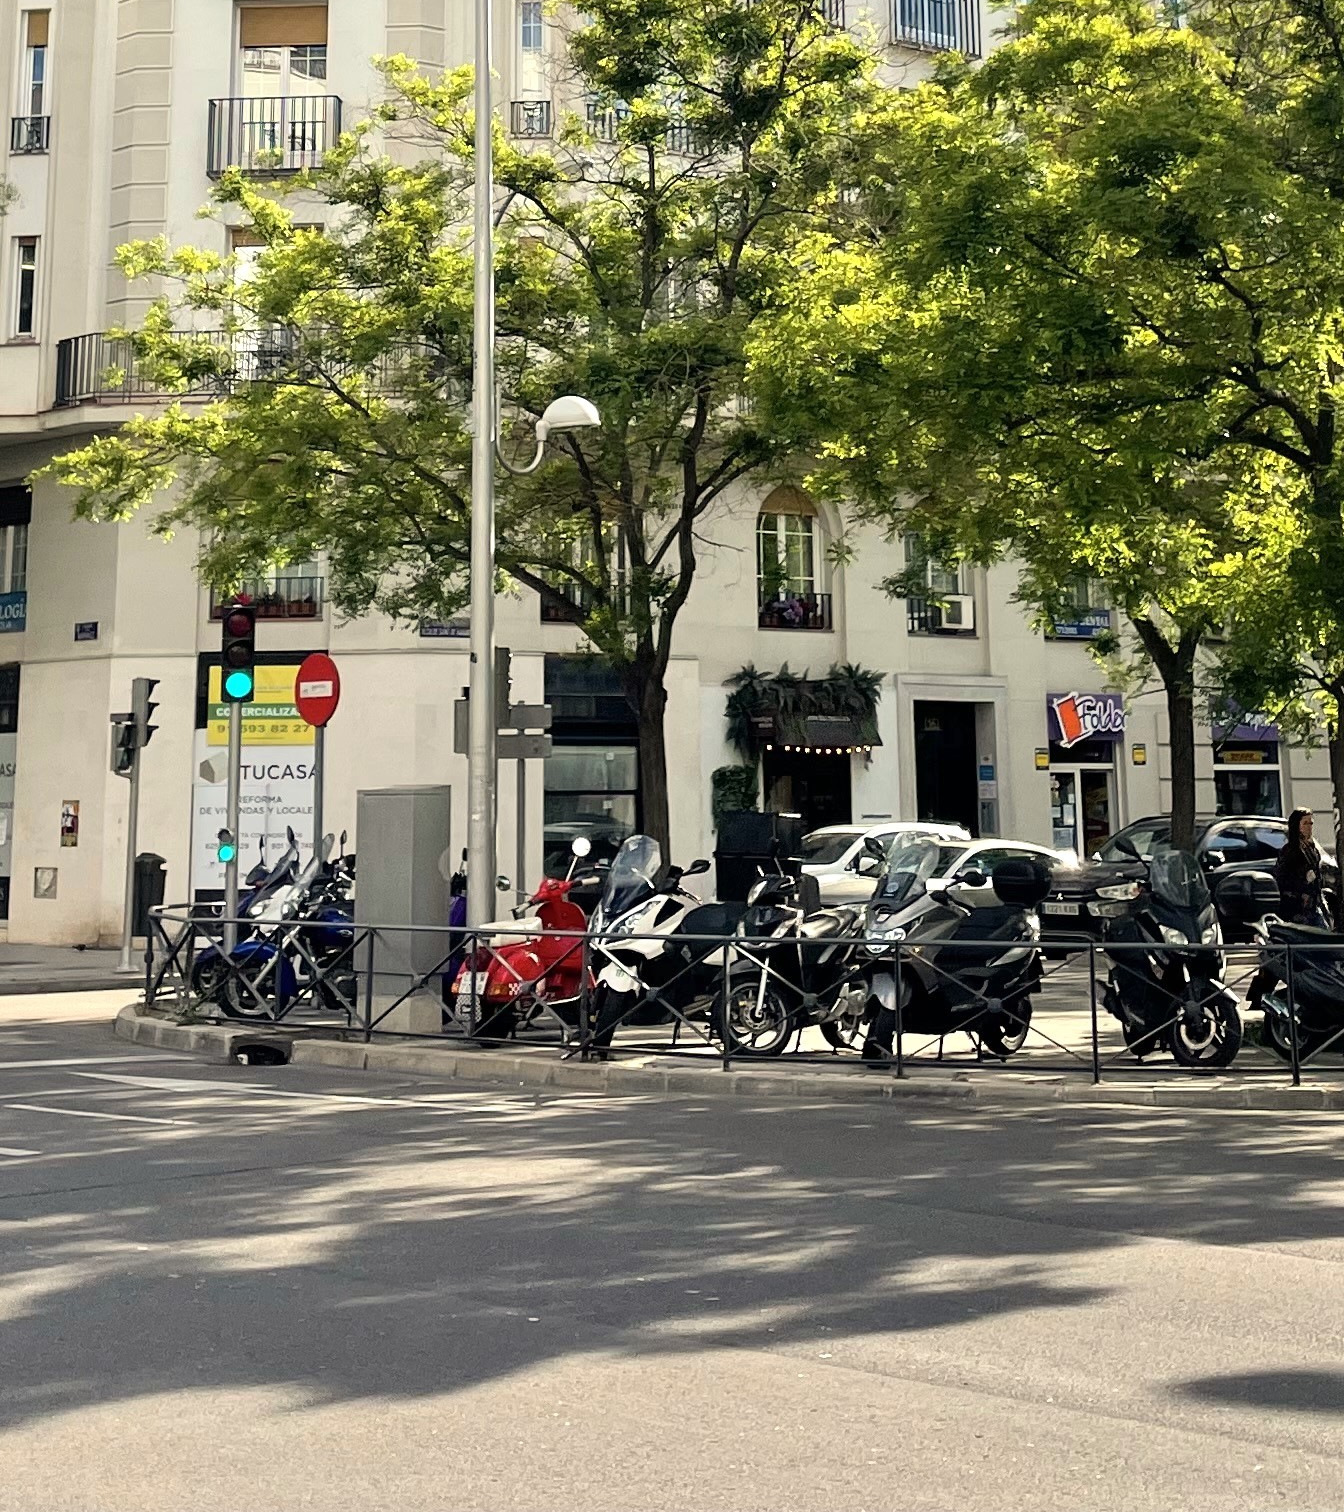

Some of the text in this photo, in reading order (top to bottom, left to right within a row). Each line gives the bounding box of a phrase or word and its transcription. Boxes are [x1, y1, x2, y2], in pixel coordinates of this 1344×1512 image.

[215, 707, 300, 717] COERCIALIZA
[271, 724, 288, 733] 82
[293, 724, 309, 733] 27
[199, 807, 212, 815] DE
